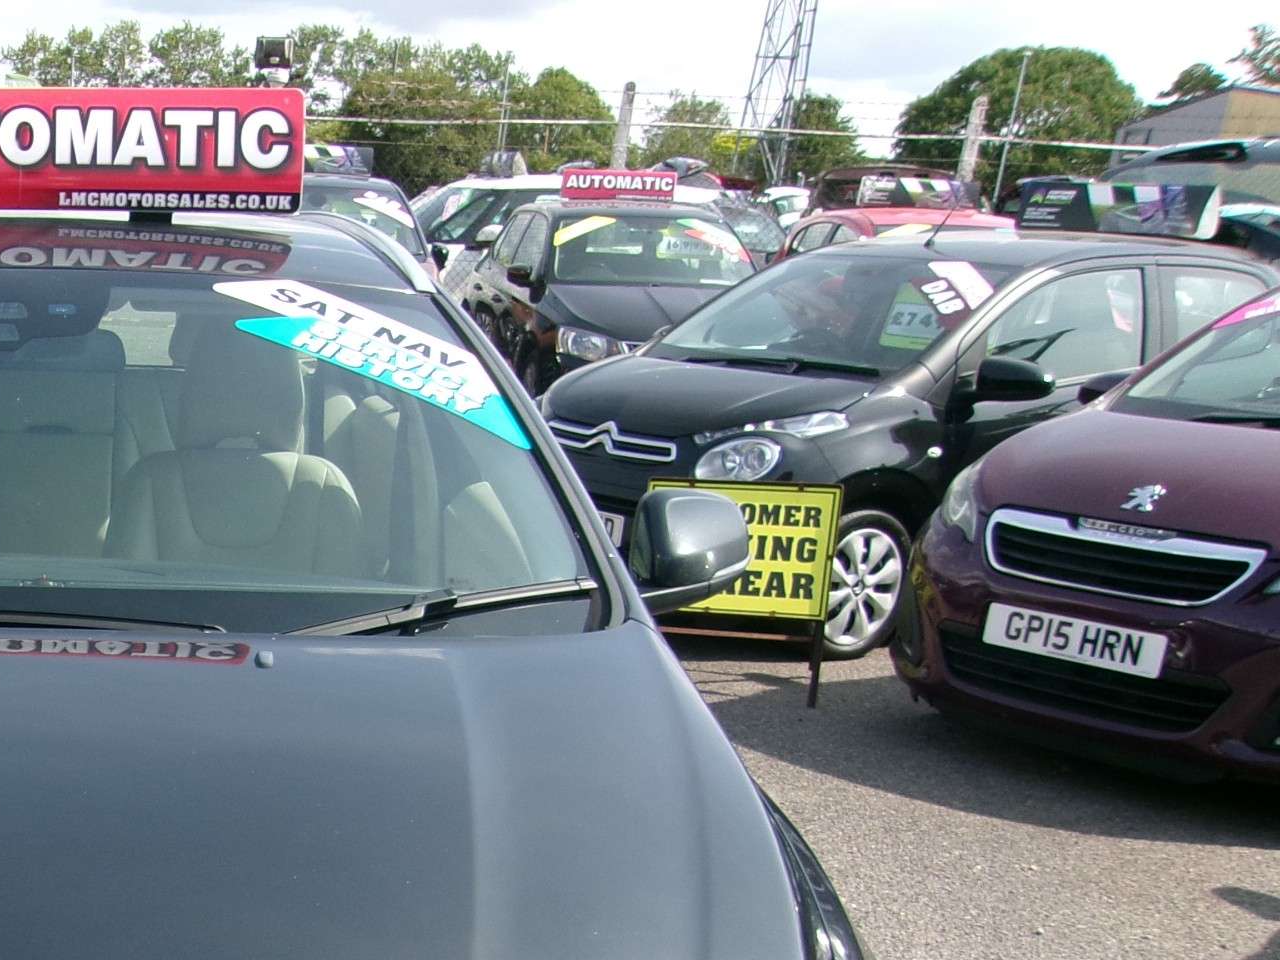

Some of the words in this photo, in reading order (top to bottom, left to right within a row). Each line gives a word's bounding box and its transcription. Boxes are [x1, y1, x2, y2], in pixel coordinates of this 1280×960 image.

[58, 191, 292, 210] LMCMOTORSALES.CO.UK
[566, 174, 674, 191] AUTOMATIC
[920, 279, 966, 315] DAB
[270, 288, 365, 324] SAT
[372, 326, 468, 368] NAV
[290, 330, 486, 414] HISTORY
[308, 320, 496, 400] SERVICE
[735, 502, 823, 529] OMER
[1004, 611, 1074, 651] GP15
[1078, 624, 1145, 667] HRN
